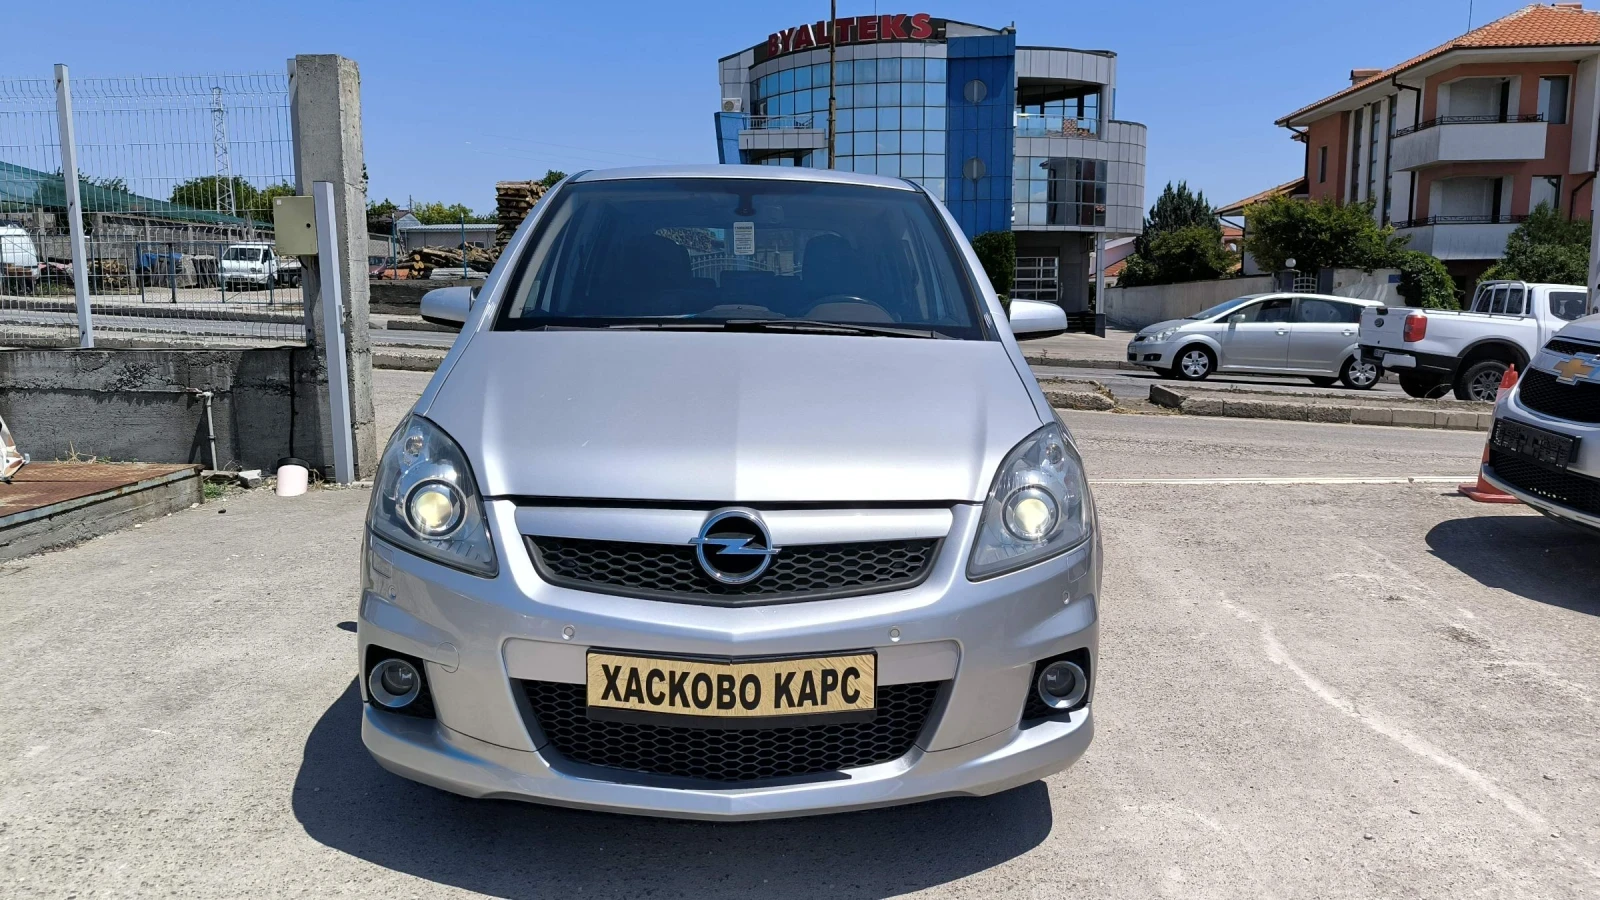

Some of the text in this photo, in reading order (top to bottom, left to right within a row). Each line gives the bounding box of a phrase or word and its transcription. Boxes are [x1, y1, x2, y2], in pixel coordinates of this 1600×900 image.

[767, 13, 933, 57] BYALTEKS
[601, 664, 860, 710] ХАСКОВО КАРС
